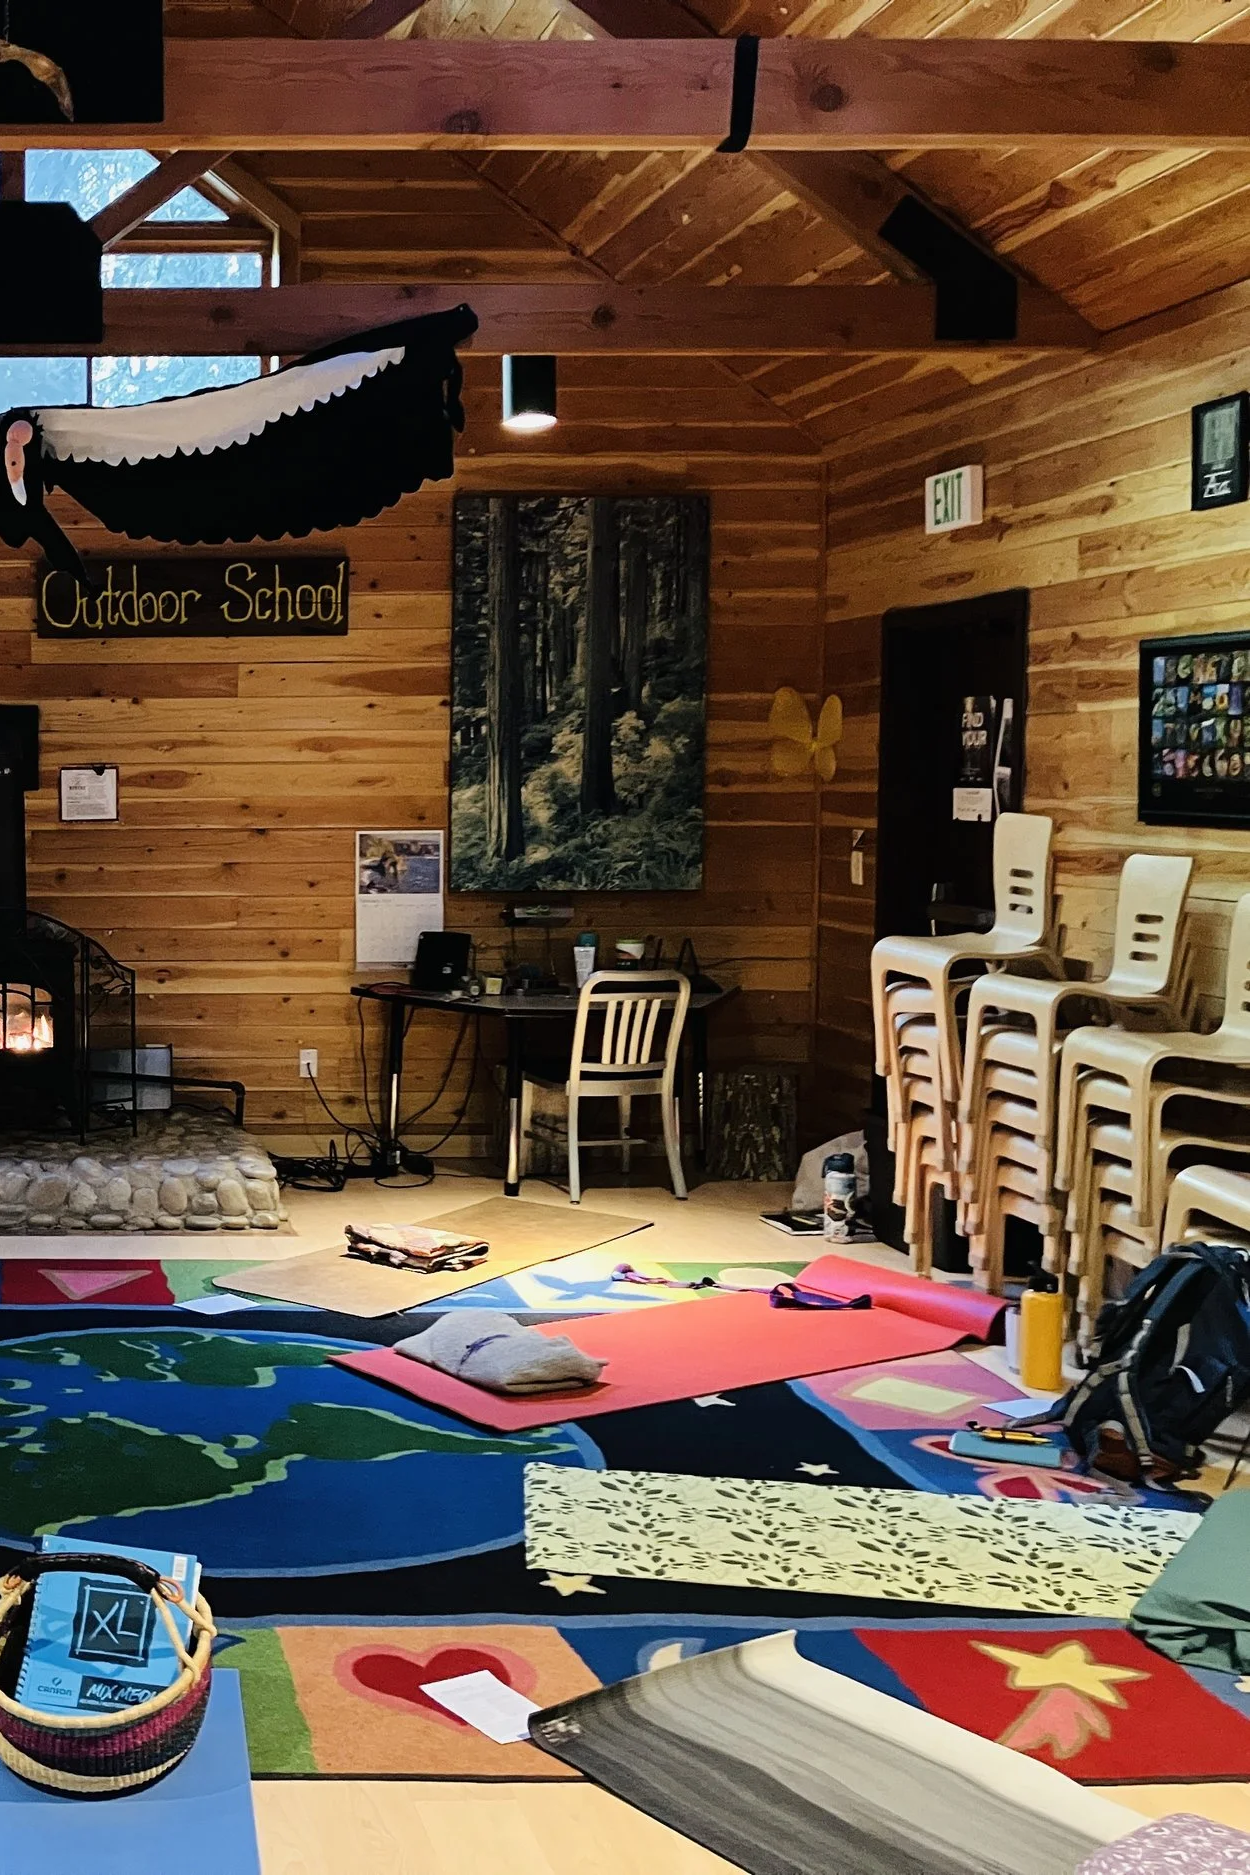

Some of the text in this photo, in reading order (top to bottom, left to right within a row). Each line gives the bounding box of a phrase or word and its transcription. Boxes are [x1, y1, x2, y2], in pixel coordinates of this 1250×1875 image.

[934, 471, 963, 526] EXIT
[42, 562, 345, 629] Outdoor School
[962, 730, 987, 746] YOUR
[90, 1598, 139, 1644] XL
[86, 1682, 118, 1699] MIX
